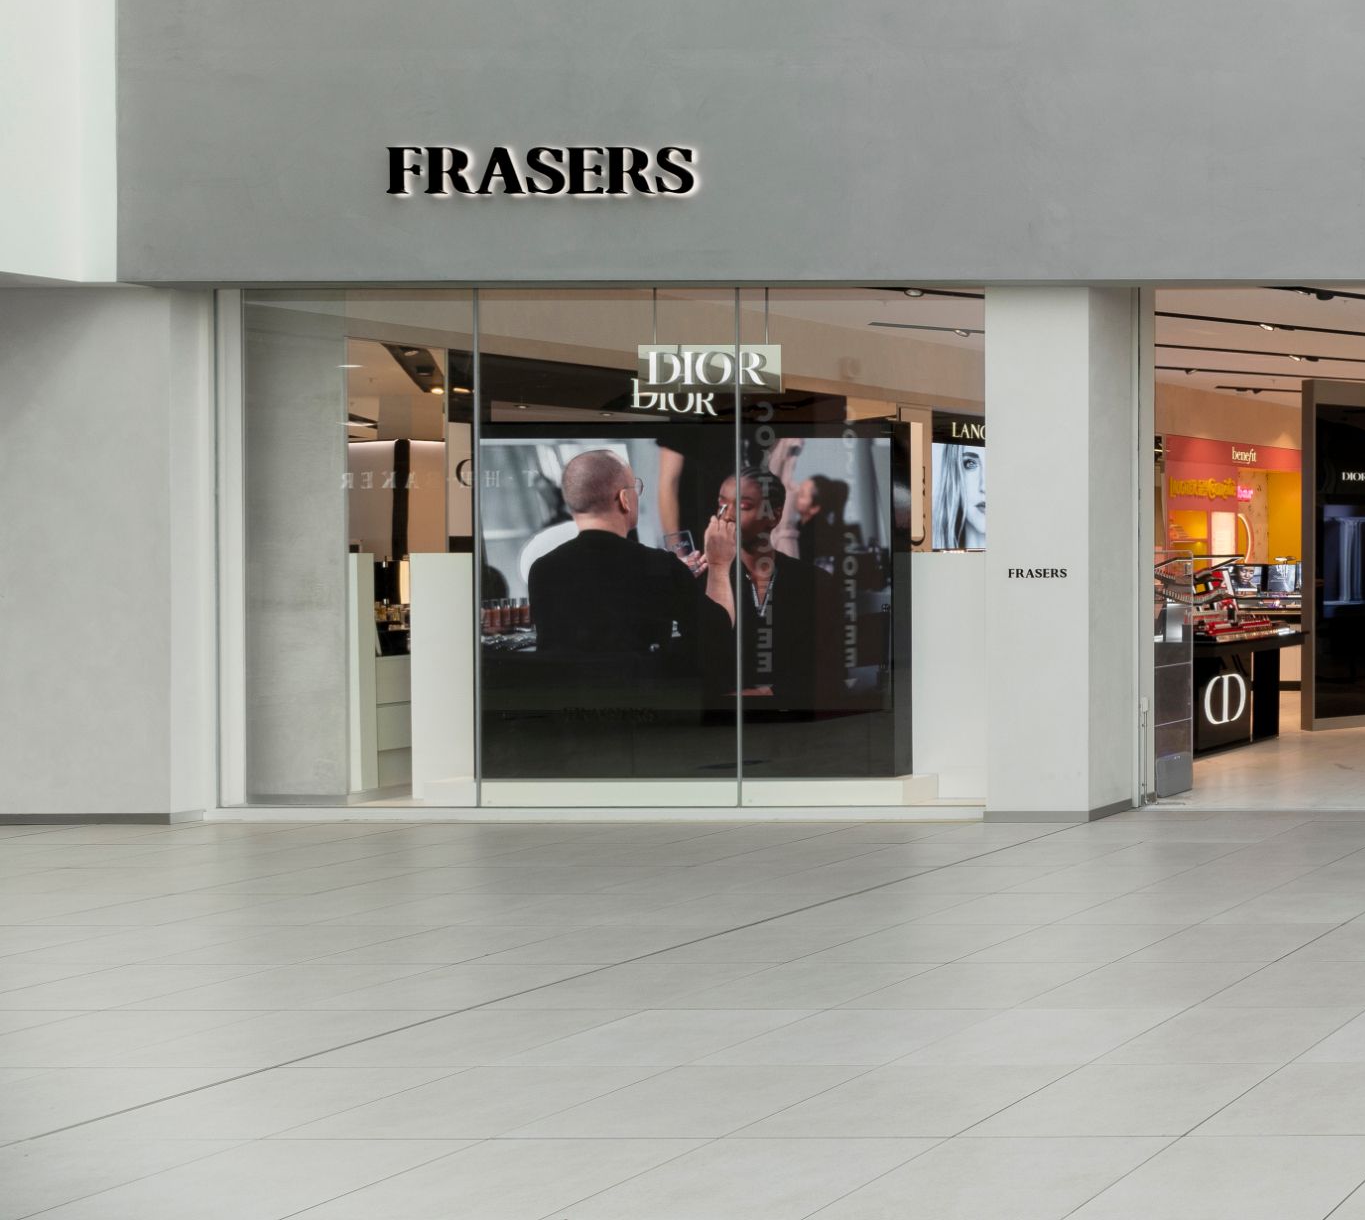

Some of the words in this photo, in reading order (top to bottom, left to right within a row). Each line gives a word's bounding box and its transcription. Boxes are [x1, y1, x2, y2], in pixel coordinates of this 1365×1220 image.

[386, 146, 695, 195] FRASERS
[646, 350, 767, 386] DIOR
[1231, 446, 1257, 464] benefit
[1008, 568, 1068, 579] FRASERS
